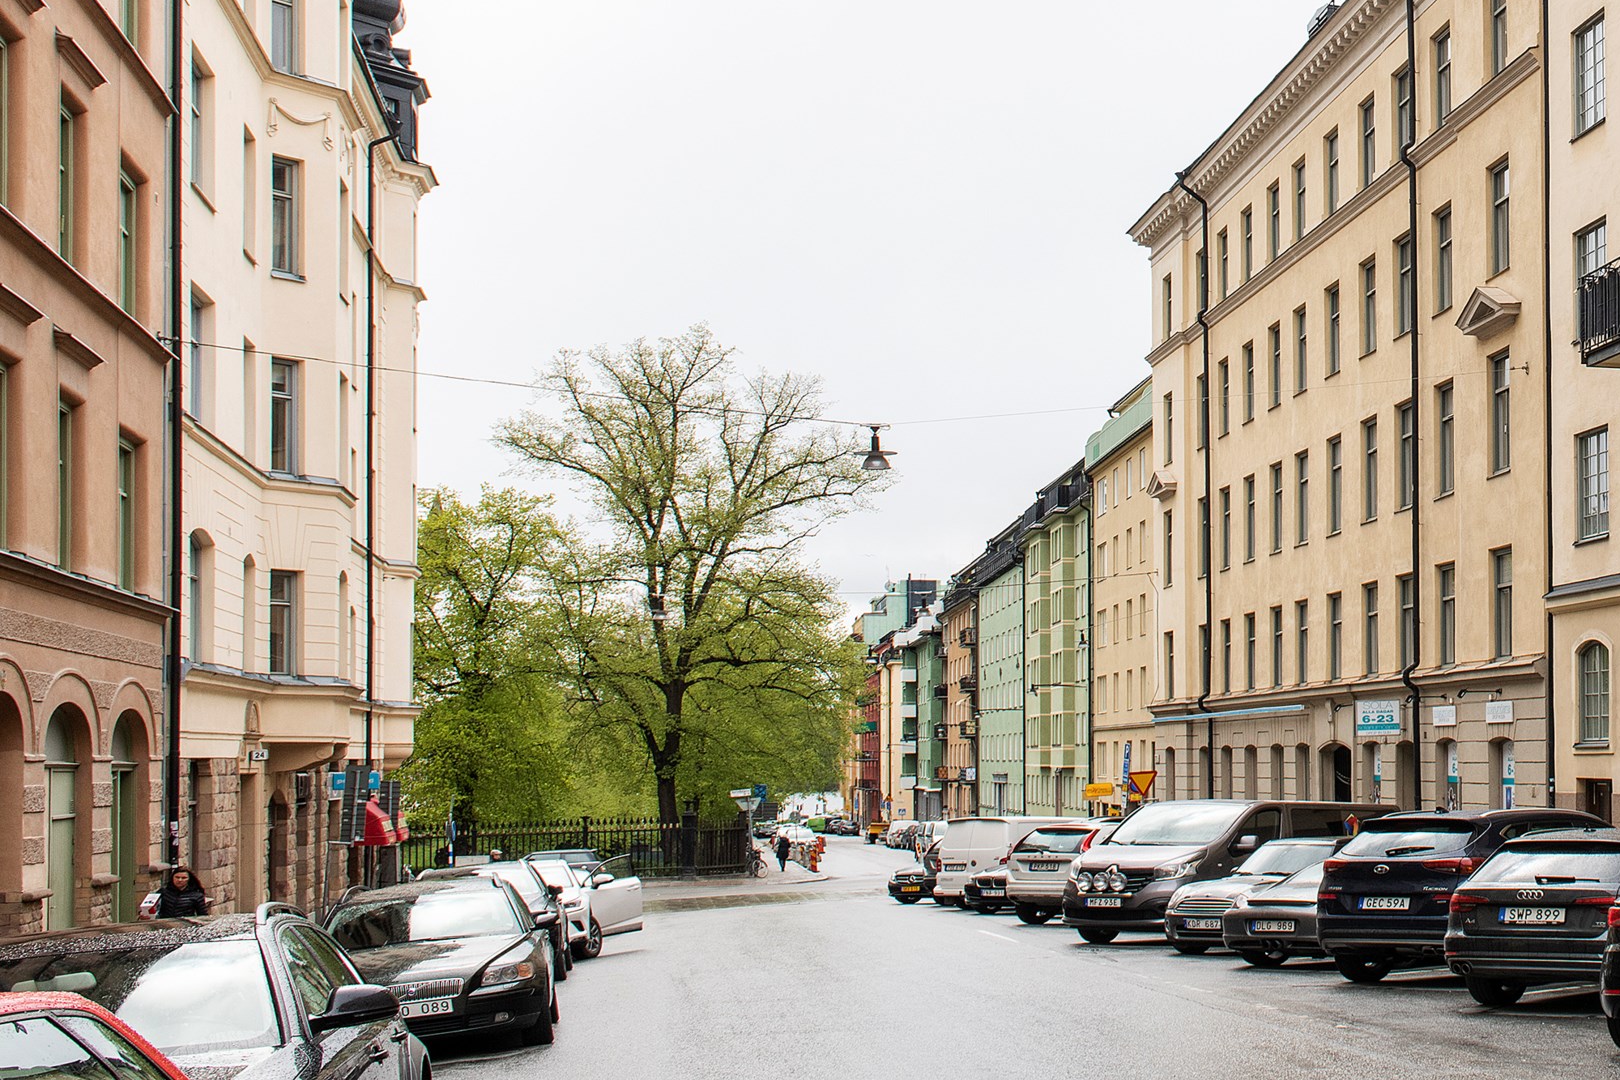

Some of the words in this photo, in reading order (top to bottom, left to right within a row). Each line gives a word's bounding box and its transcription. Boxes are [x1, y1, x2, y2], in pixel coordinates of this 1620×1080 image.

[1363, 701, 1393, 710] SOLA
[1362, 714, 1394, 723] 6-23
[1366, 898, 1385, 908] GEC
[1386, 898, 1405, 908] 59A
[1509, 908, 1533, 920] SWP
[1535, 909, 1561, 920] 899
[1277, 921, 1293, 930] 969
[421, 1001, 450, 1014] 089
